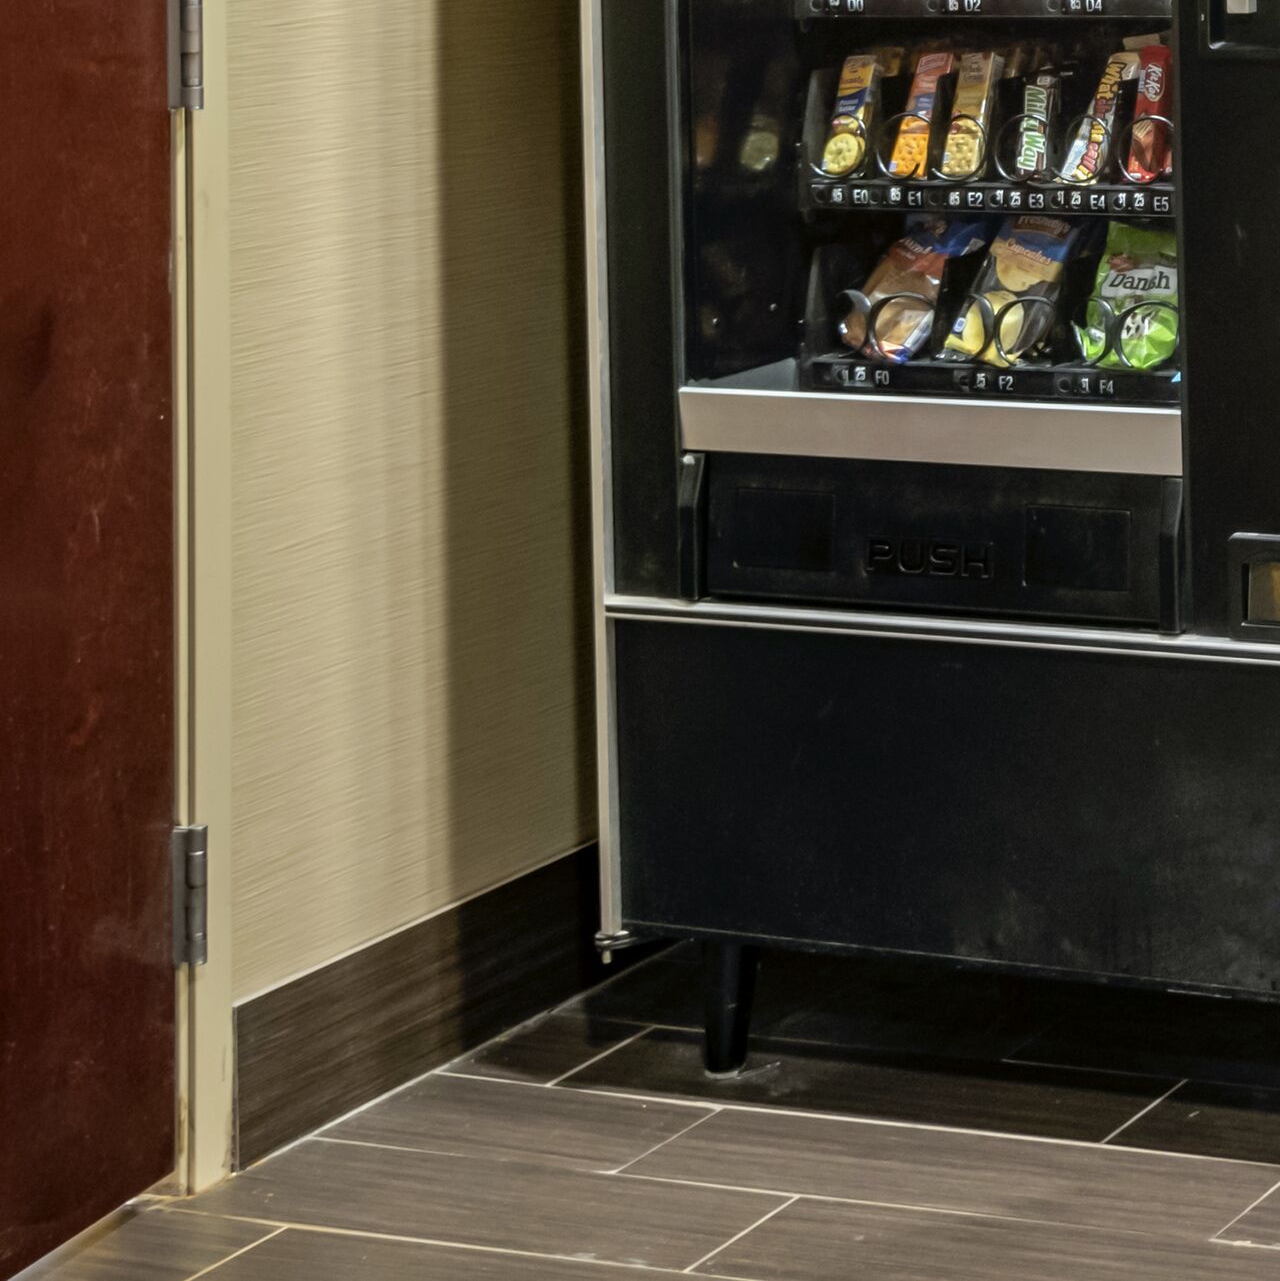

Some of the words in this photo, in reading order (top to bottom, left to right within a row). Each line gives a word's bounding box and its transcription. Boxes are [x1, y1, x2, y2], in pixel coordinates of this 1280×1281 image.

[853, 189, 868, 203] E0
[907, 191, 922, 205] E1
[967, 192, 983, 206] E2
[1029, 194, 1044, 208] E3
[1090, 195, 1105, 209] E4
[1154, 196, 1169, 210] E5
[1005, 238, 1052, 265] Cupcakes
[875, 370, 890, 385] F0
[998, 375, 1014, 391] F2
[1100, 379, 1114, 393] F4
[867, 541, 994, 579] PUSH
